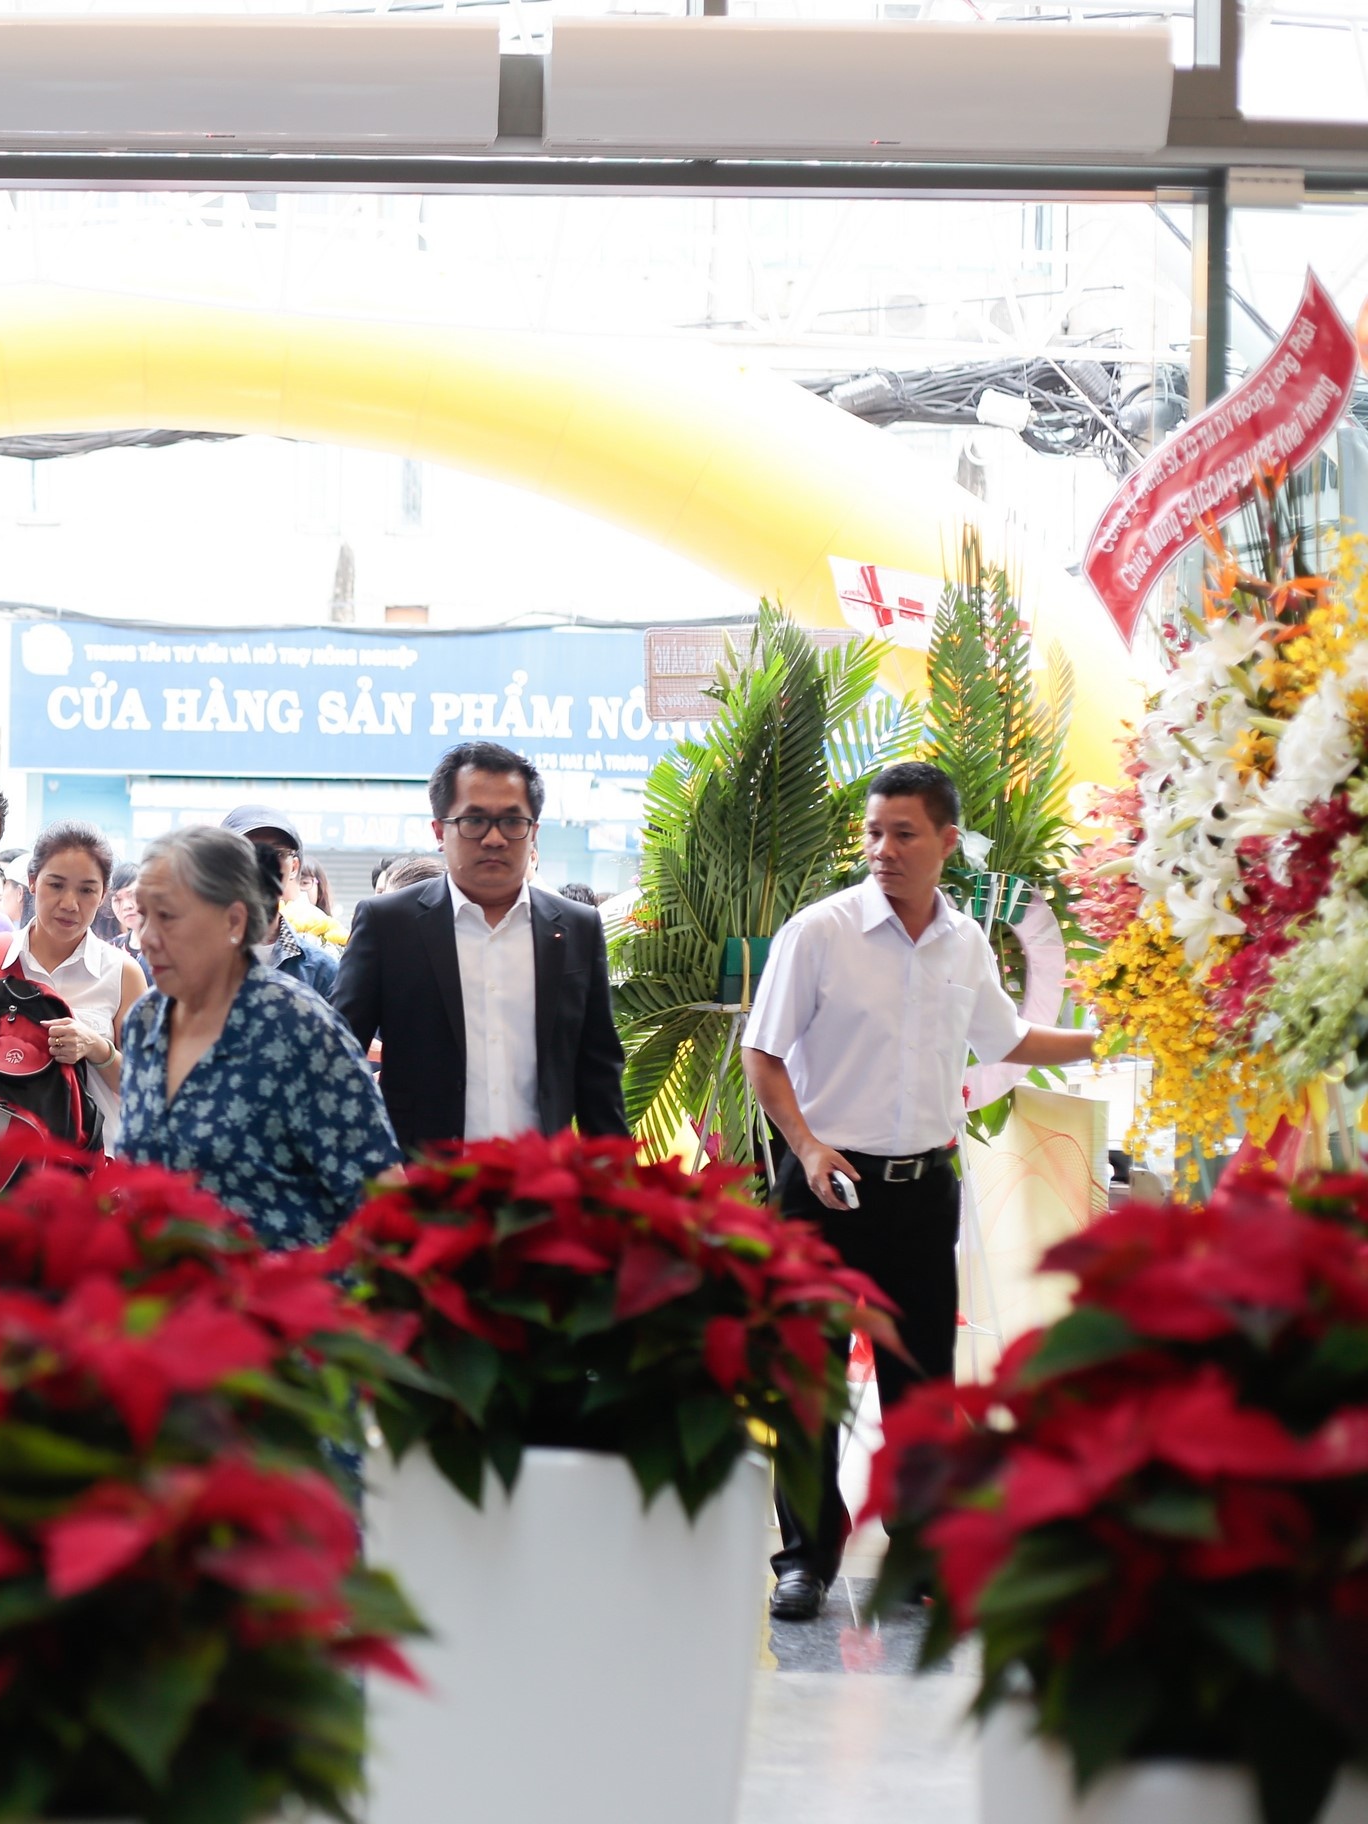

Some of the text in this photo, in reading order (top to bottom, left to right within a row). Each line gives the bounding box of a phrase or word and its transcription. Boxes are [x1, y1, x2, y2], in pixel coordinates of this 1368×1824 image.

[1164, 445, 1184, 475] SX
[1197, 423, 1221, 450] TM
[1215, 407, 1235, 441] DV
[1232, 381, 1275, 424] Hoàng
[1270, 351, 1301, 392] Long
[1288, 316, 1318, 357] Phát
[1119, 545, 1153, 591] Chúc
[1178, 467, 1231, 527] SAIGON
[1274, 411, 1306, 458] Khai
[47, 671, 151, 732] CỬA
[162, 678, 305, 735] HÀNG
[317, 675, 417, 736] SẢN
[430, 669, 573, 739] PHẨM
[585, 750, 603, 771] BÀ
